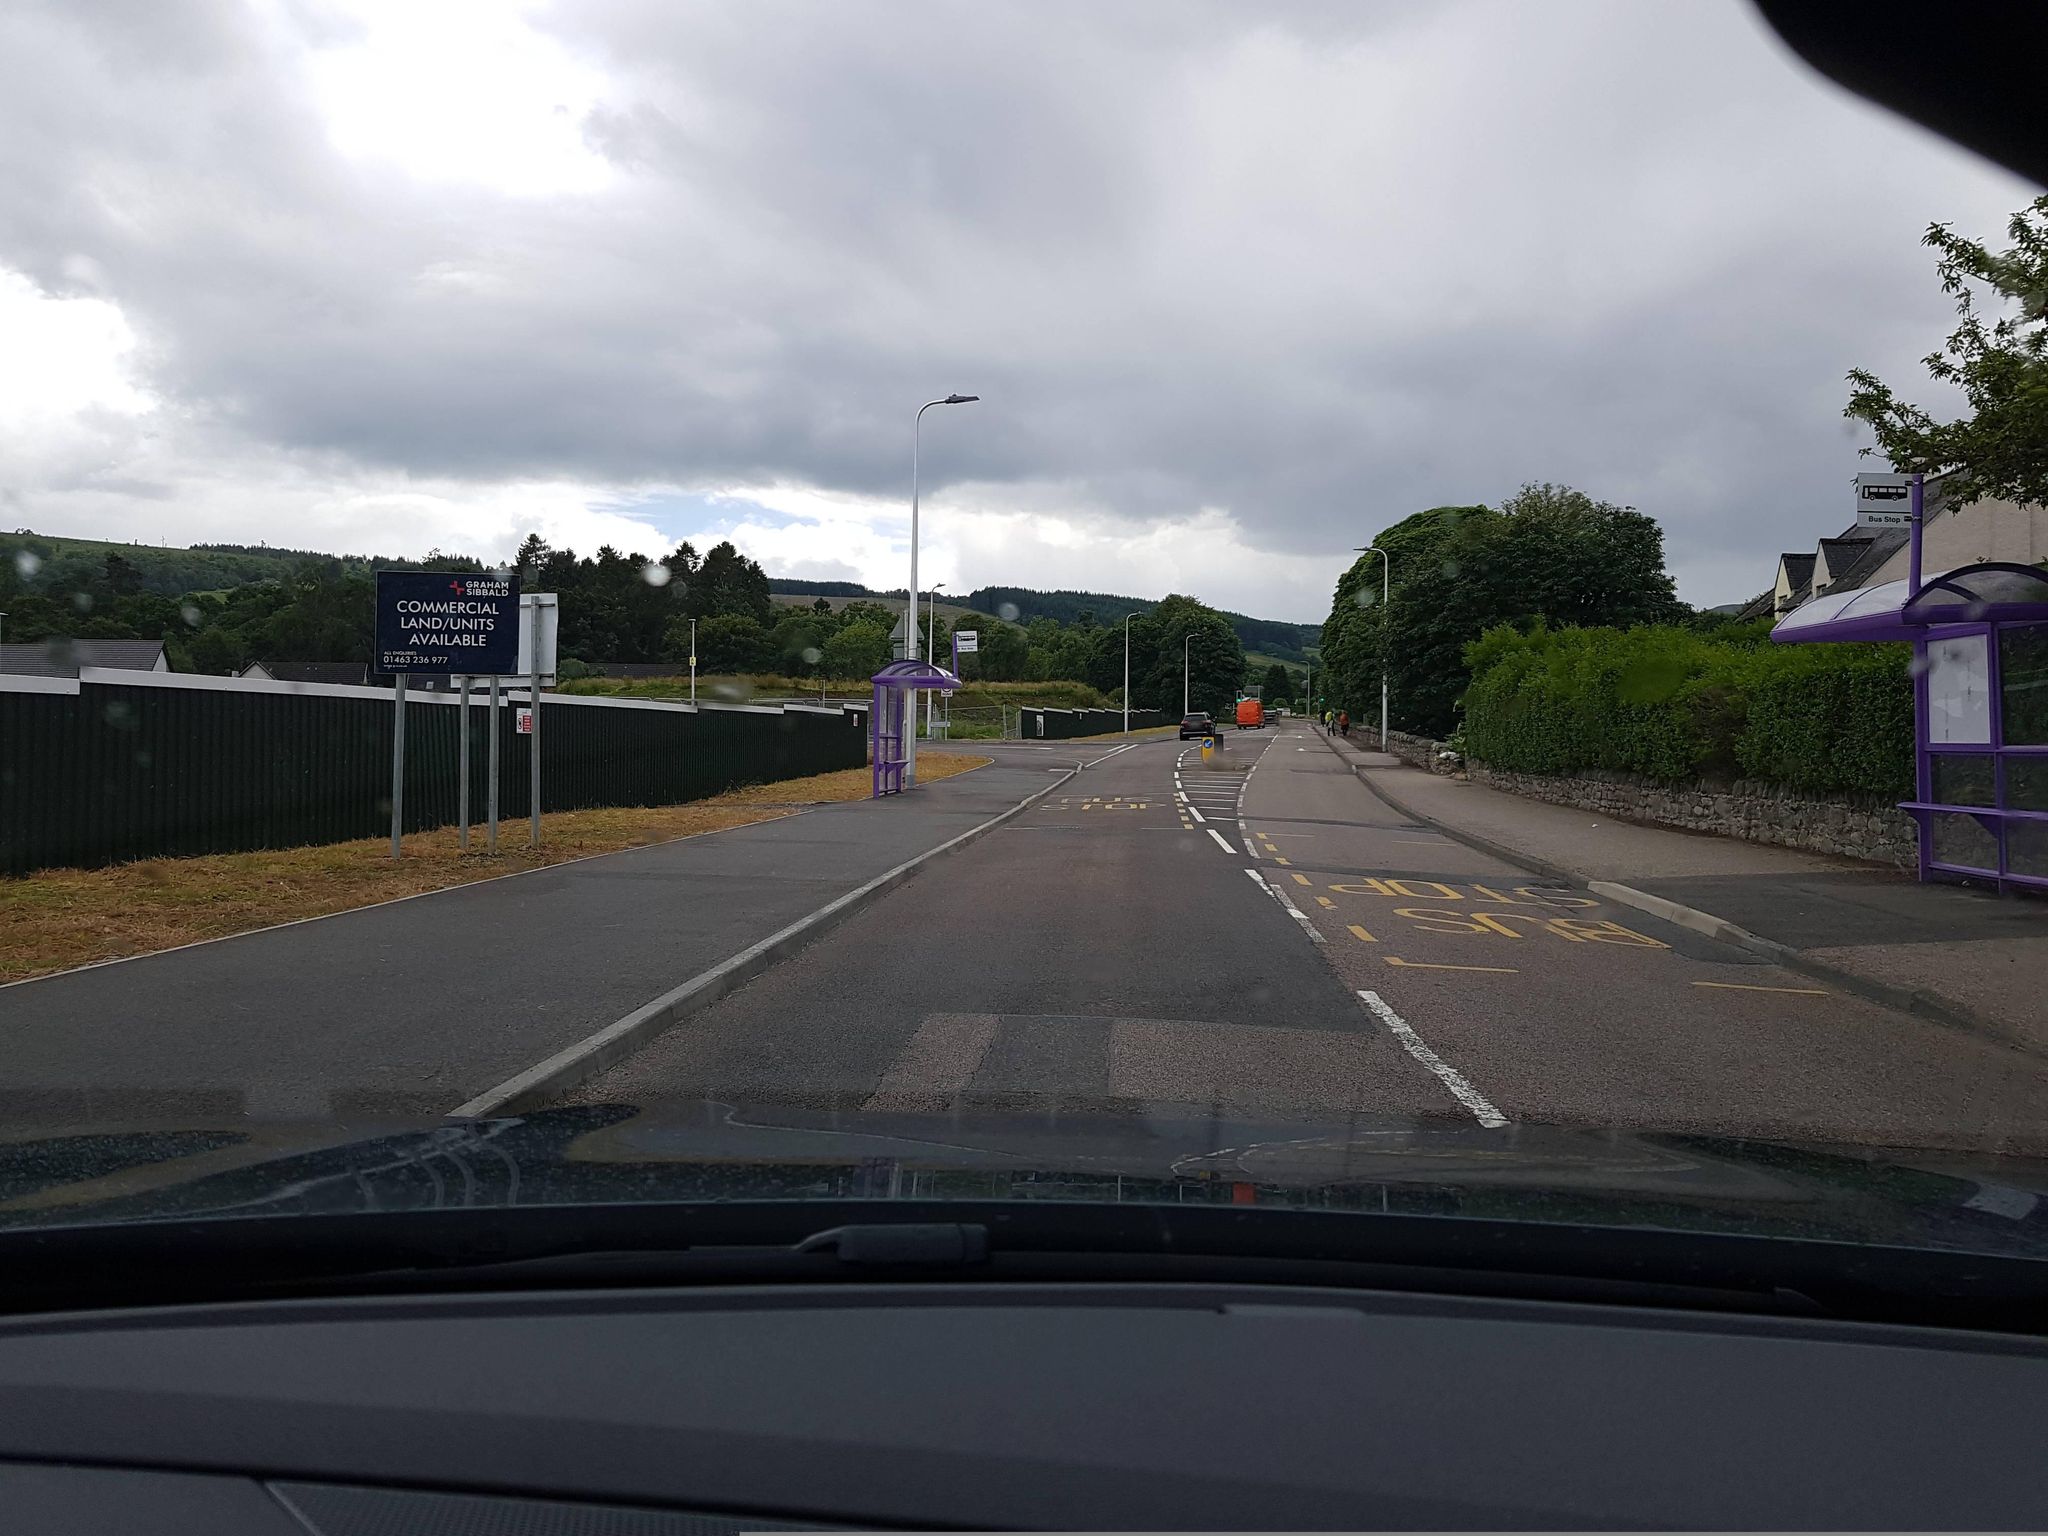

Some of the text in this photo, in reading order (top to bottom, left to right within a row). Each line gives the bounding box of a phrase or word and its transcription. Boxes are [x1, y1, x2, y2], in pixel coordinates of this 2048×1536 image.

[466, 581, 509, 589] GRAHAM
[466, 589, 509, 597] SIBBALD
[397, 600, 499, 615] COMMERCIAL
[401, 617, 495, 631] LAND/UNITS
[409, 633, 487, 647] AVAILABLE
[383, 656, 448, 664] 01463 236 977
[1328, 878, 1602, 908] STOP
[1392, 908, 1673, 949] BUS
